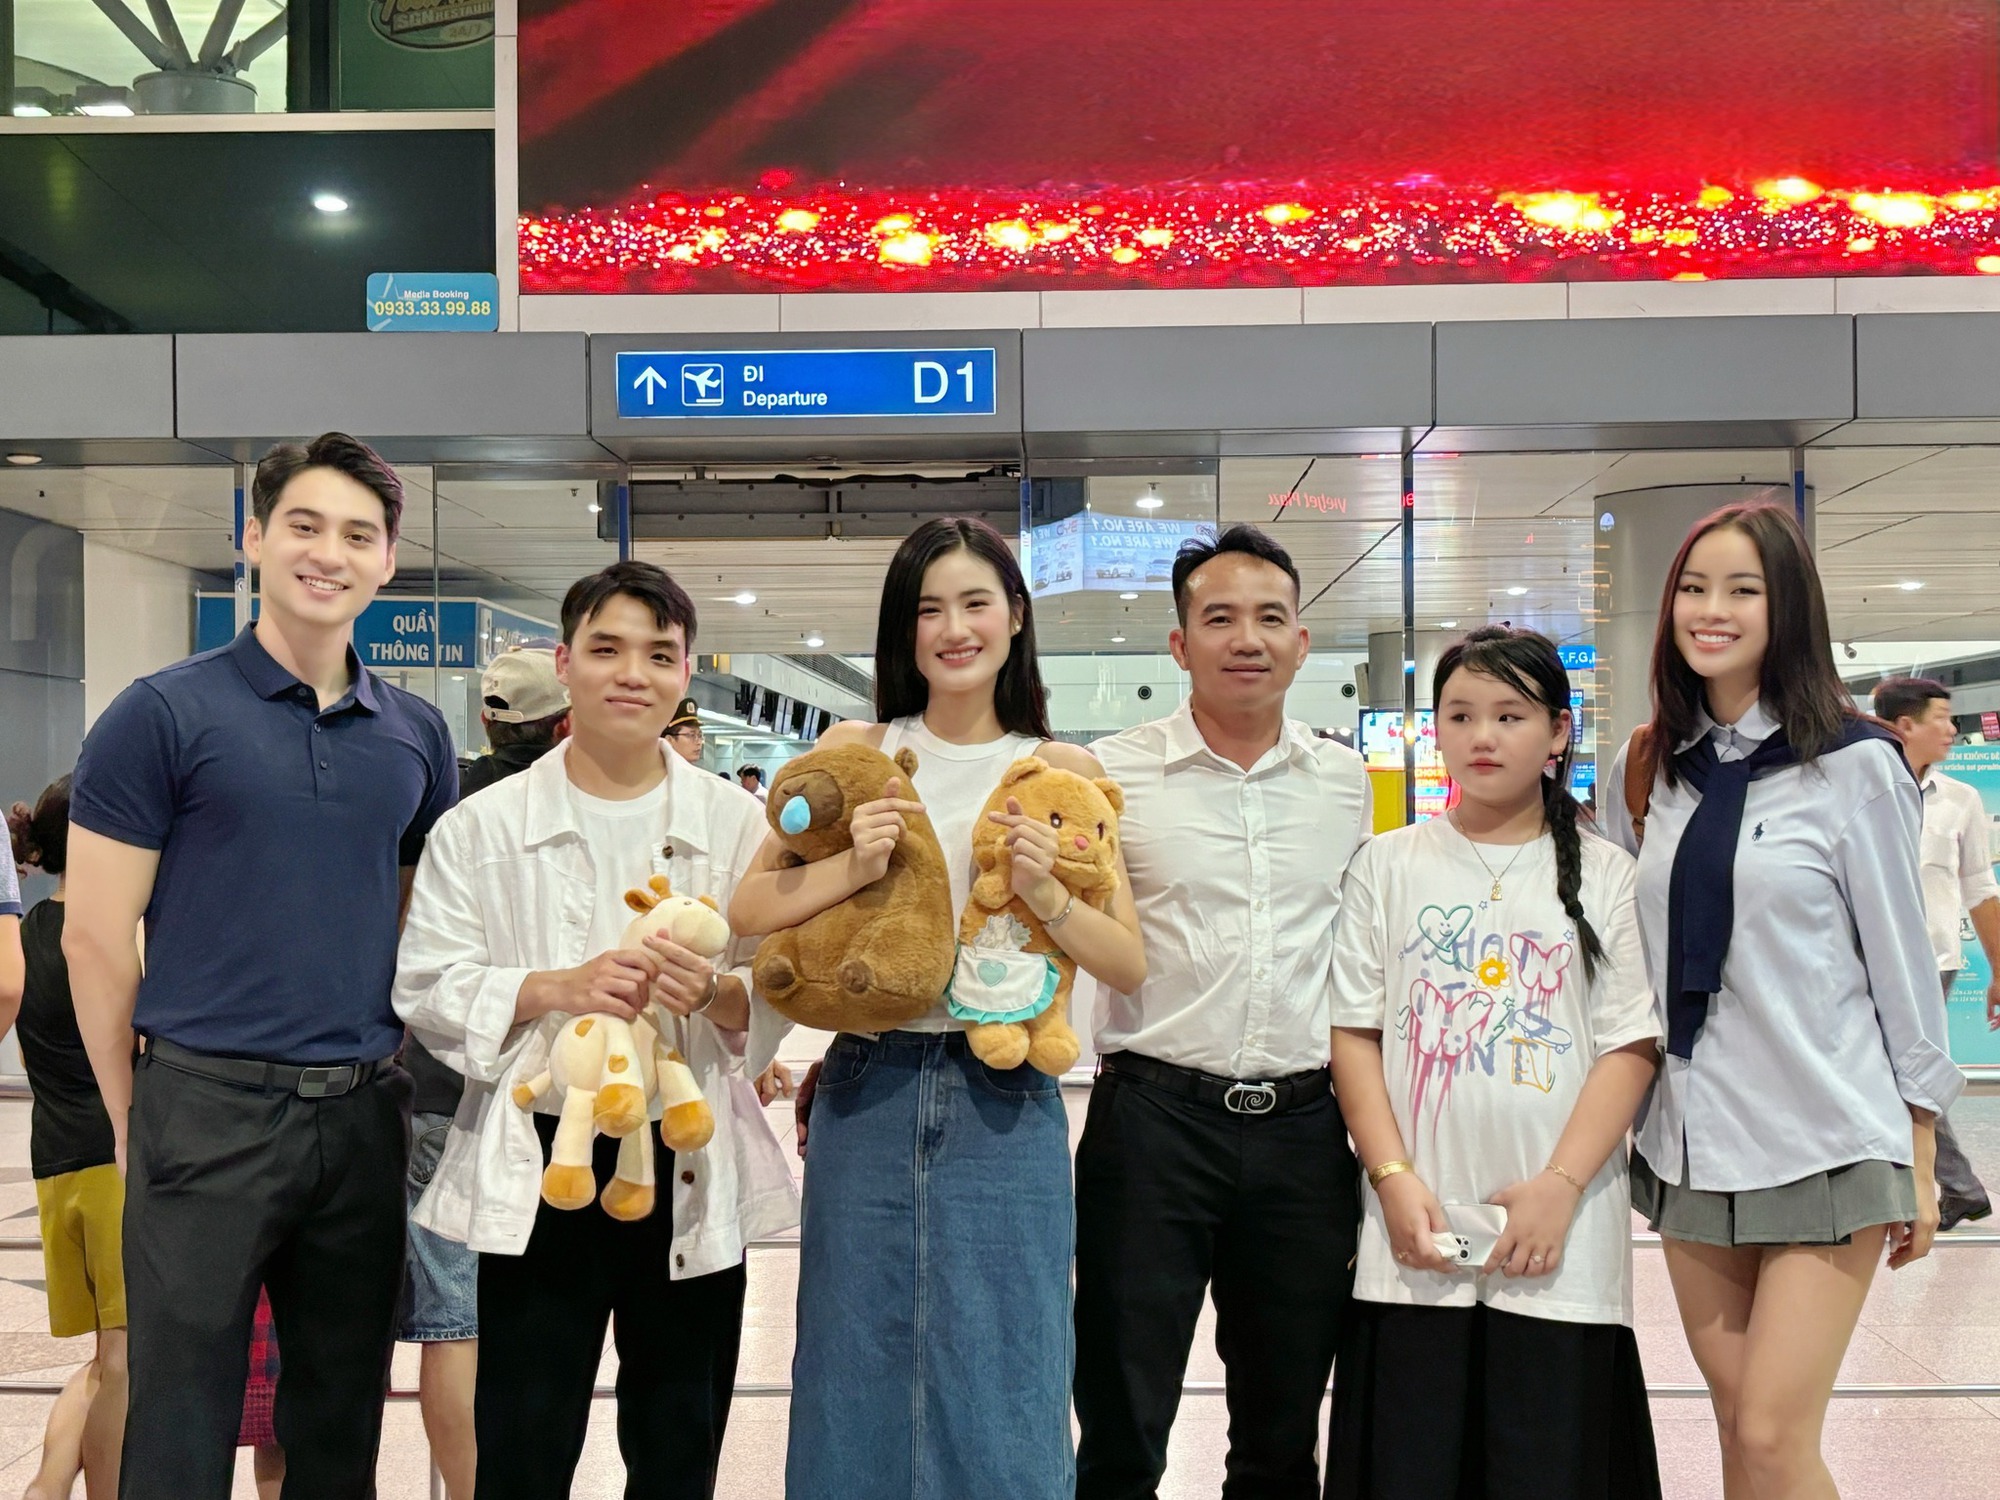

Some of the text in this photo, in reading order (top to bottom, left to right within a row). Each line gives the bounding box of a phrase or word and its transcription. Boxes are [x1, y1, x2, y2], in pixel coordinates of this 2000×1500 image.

[403, 289, 470, 300] Media Booking
[374, 300, 491, 316] 0933.33.99.88
[743, 365, 764, 382] ĐI
[914, 361, 973, 403] D1
[743, 390, 828, 410] Departure
[369, 640, 429, 661] THÔNG
